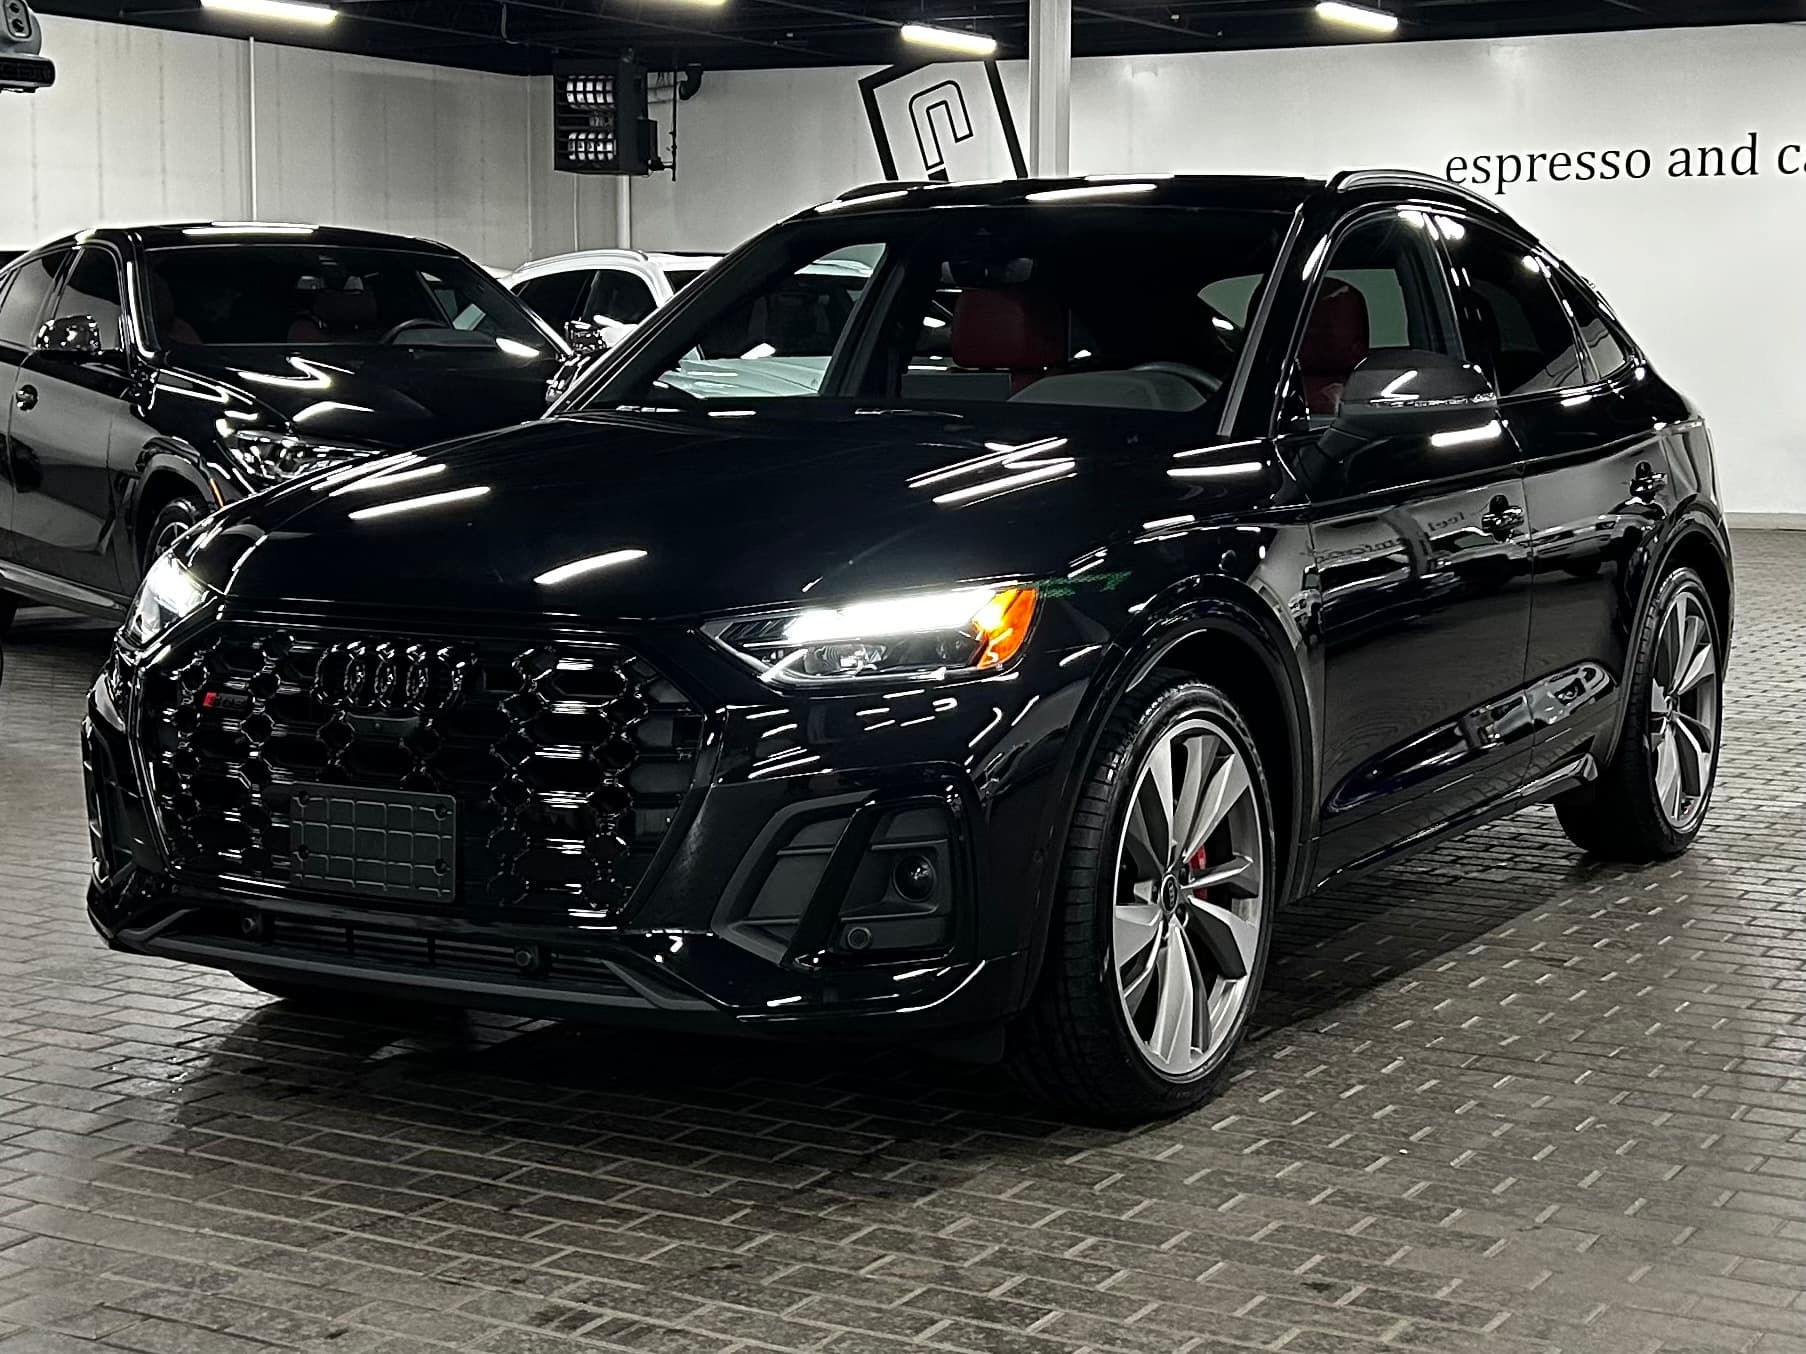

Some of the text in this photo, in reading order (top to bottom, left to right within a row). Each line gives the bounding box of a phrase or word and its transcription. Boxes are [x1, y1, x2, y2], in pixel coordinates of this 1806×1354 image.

[1445, 132, 1806, 195] espresso and c
